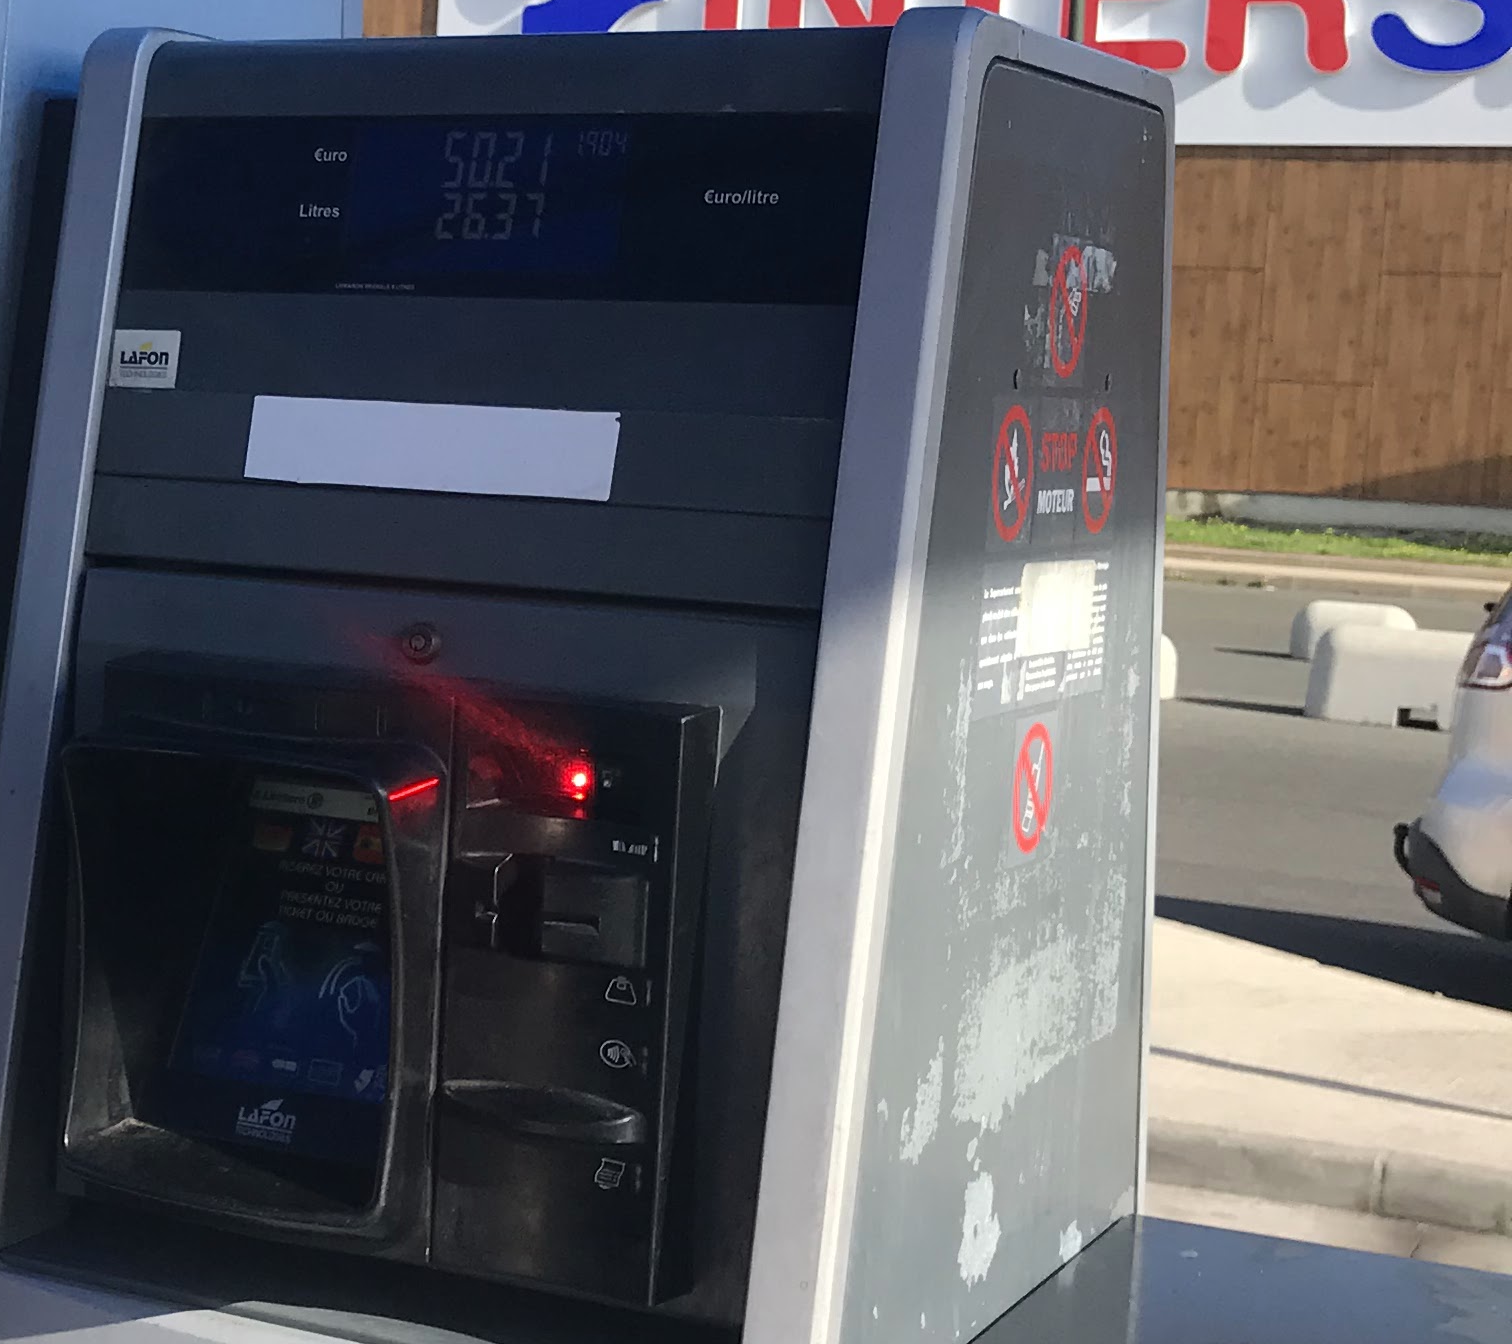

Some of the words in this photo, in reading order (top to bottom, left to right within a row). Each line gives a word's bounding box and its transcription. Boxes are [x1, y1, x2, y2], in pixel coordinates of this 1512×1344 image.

[314, 147, 348, 163] €uro
[703, 188, 780, 206] €uro/litre
[299, 203, 340, 218] Litres
[120, 351, 169, 366] LAFON
[1040, 432, 1078, 472] STOP
[1037, 489, 1075, 514] MOTEUR
[325, 866, 362, 881] VOTRE
[325, 880, 345, 894] OU
[344, 897, 384, 913] VOTRE
[316, 910, 333, 923] OU
[337, 914, 377, 928] BADGE
[237, 1106, 297, 1130] LAFON
